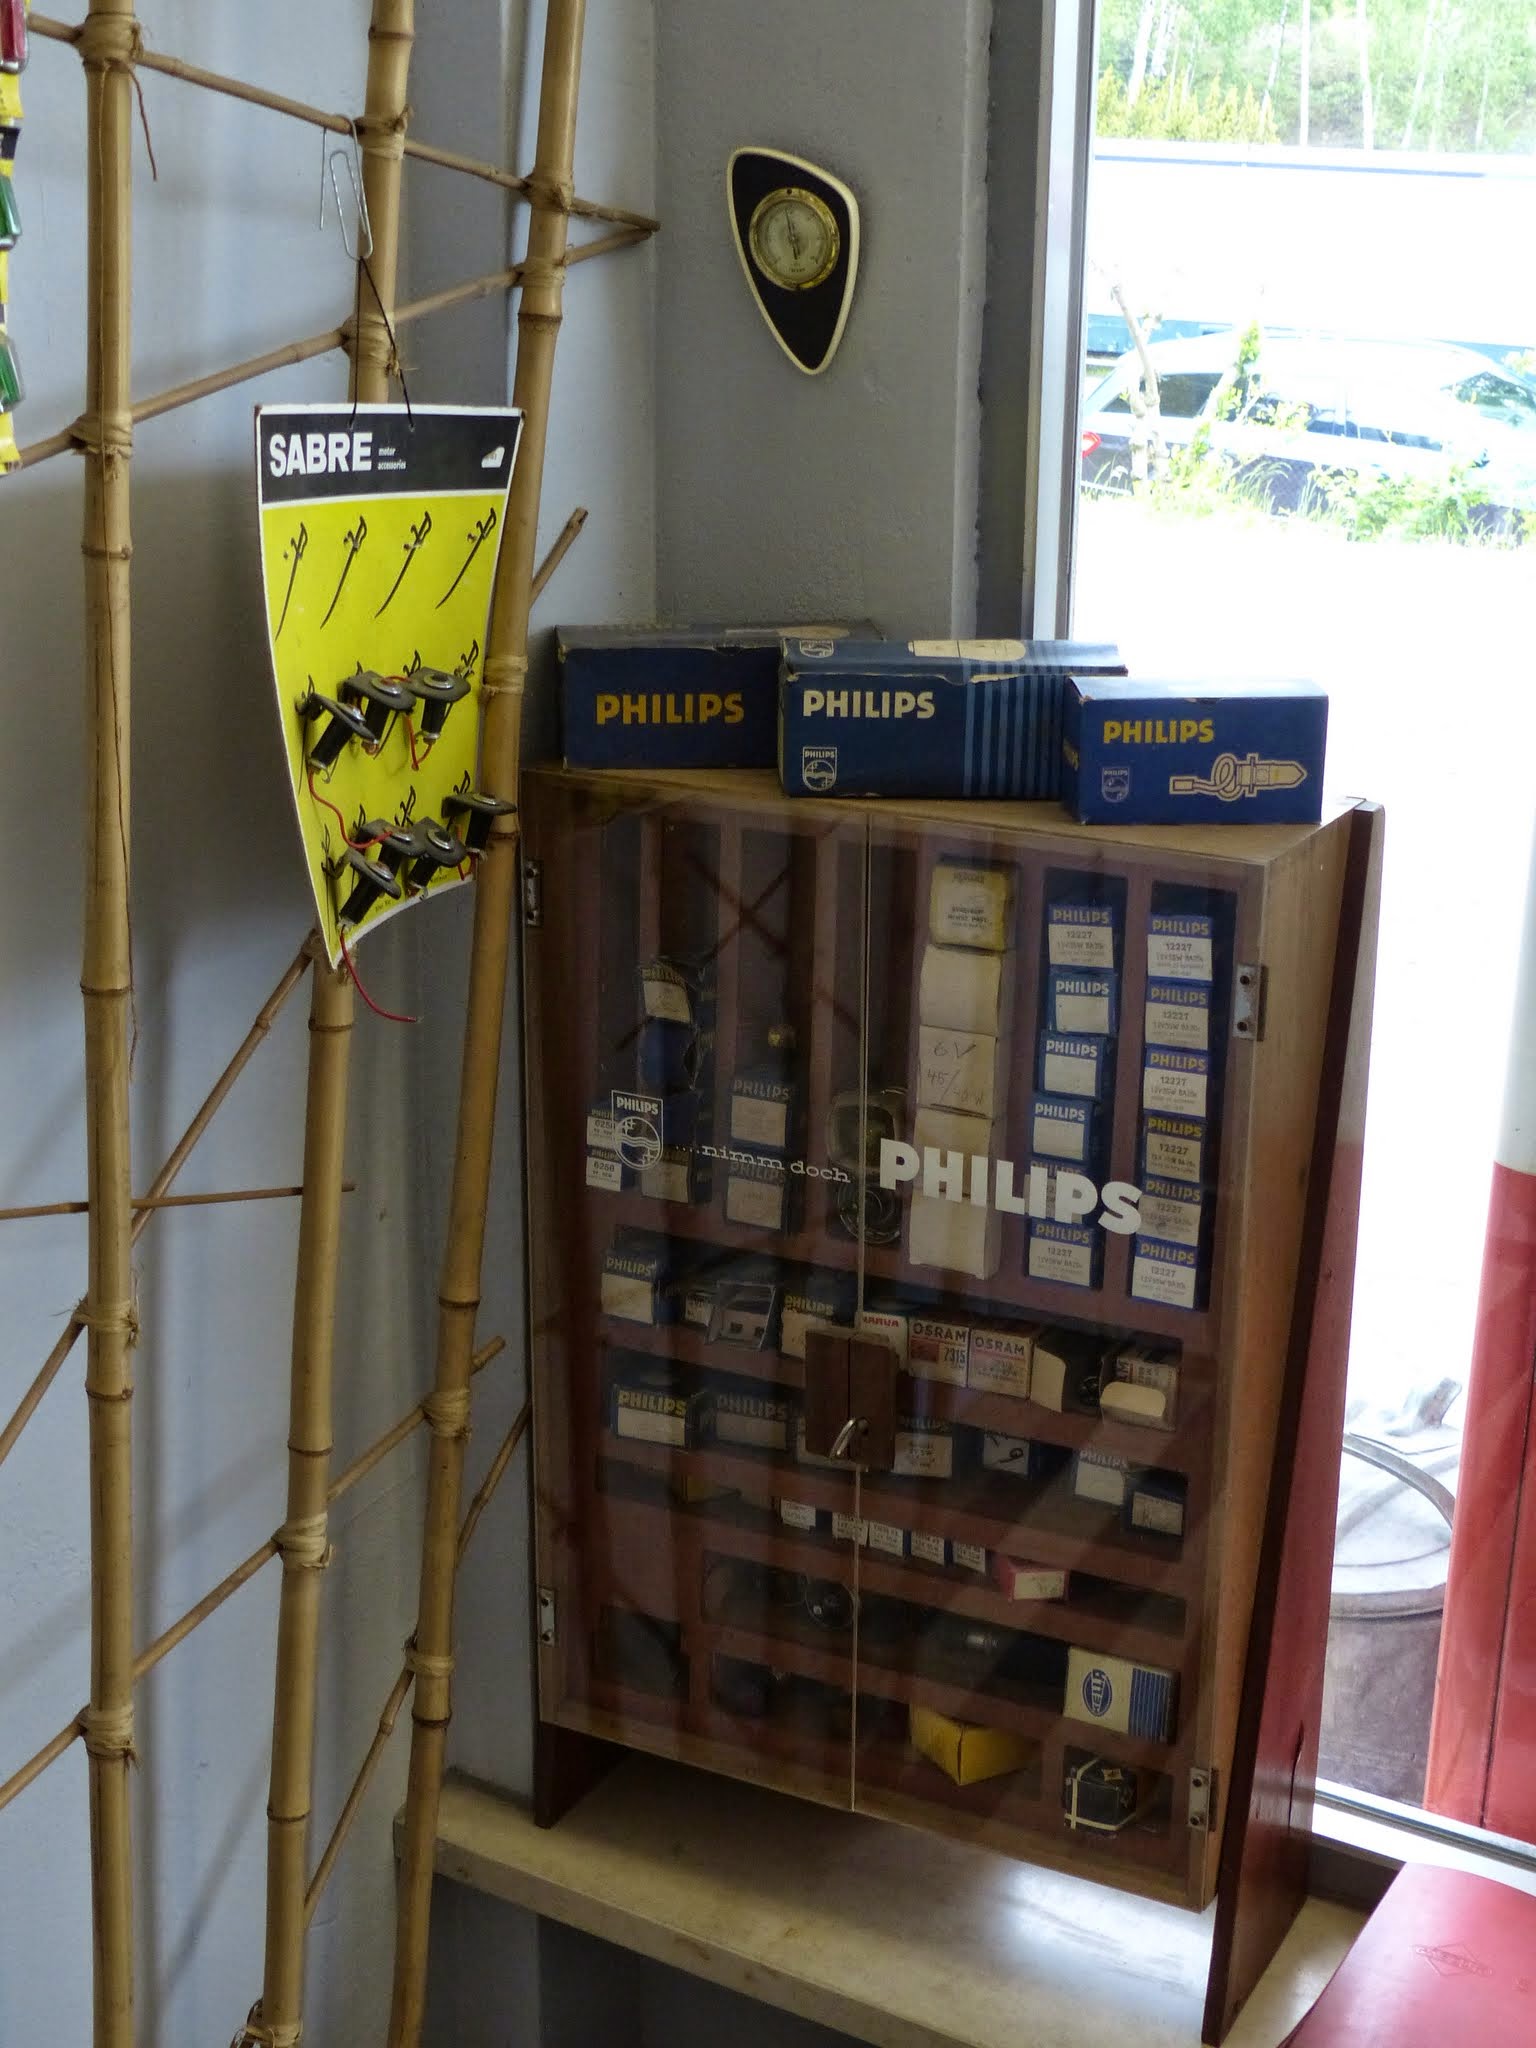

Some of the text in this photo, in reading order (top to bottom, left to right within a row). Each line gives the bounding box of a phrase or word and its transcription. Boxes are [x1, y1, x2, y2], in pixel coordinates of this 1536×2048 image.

[269, 432, 373, 478] SABRE
[595, 692, 745, 726] PHILIPS
[802, 689, 936, 719] PHILIPS
[1102, 719, 1215, 745] PHILIPS
[804, 750, 836, 759] PHILIPS
[1052, 908, 1109, 924] PHILIPS
[1151, 918, 1210, 936] PHILIPS
[1165, 942, 1192, 952] 12227
[1056, 980, 1109, 995] PHILIPS
[1150, 986, 1207, 1005] PHILIPS
[1162, 1010, 1189, 1021] 12227
[1045, 1039, 1098, 1058] PHILIPS
[1150, 1052, 1207, 1071] PHILIPS
[1159, 1075, 1188, 1086] 12227
[616, 1097, 659, 1116] PHILIPS
[1034, 1103, 1086, 1122] PHILIPS
[1148, 1116, 1202, 1138] PHILIPS
[1159, 1142, 1189, 1156] 12227
[790, 1160, 852, 1184] doch
[880, 1137, 1143, 1236] PHILIPS
[1145, 1180, 1201, 1202] PHILIPS
[1036, 1223, 1090, 1243] PHILIPS
[1140, 1242, 1195, 1265] PHILIPS
[606, 1255, 653, 1276] PHILIPS
[784, 1294, 834, 1317] PHILIPS
[913, 1322, 967, 1342] OSRAM
[975, 1336, 1025, 1356] OSRAM
[617, 1389, 688, 1417] PHILIPS
